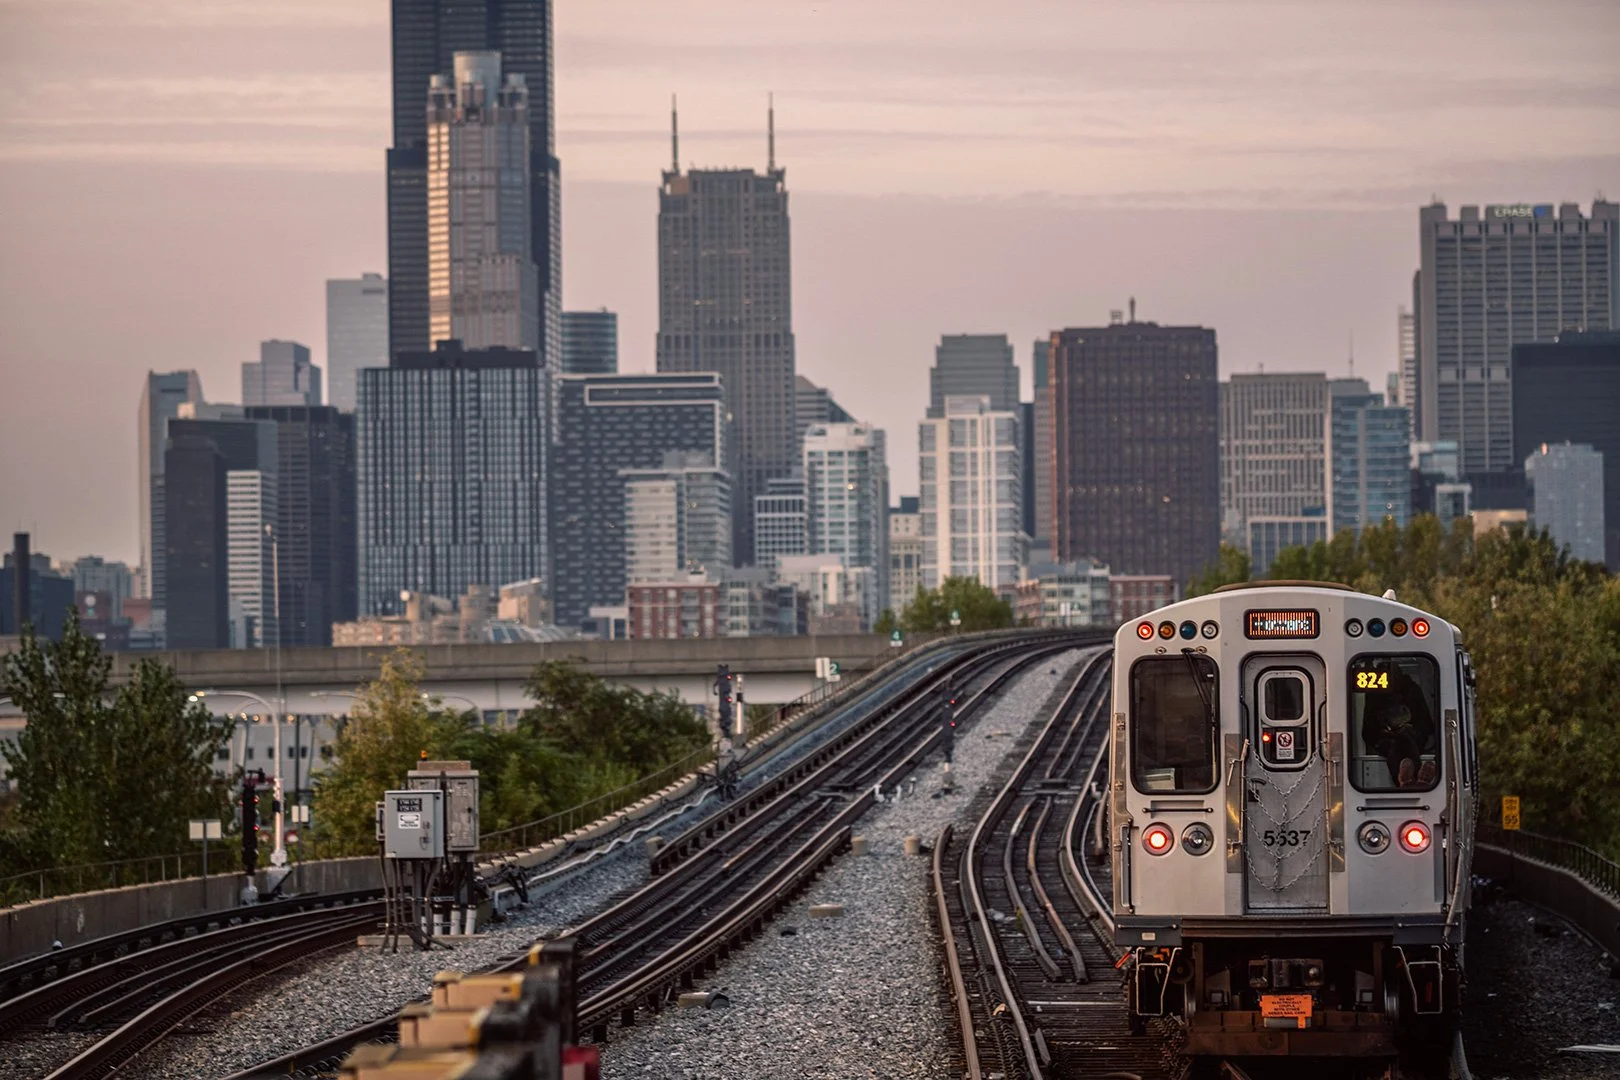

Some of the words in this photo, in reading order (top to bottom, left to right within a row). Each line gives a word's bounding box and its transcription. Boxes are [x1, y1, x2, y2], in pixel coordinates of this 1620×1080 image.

[892, 630, 900, 641] 4
[829, 663, 838, 675] 2
[1356, 671, 1389, 689] 824
[1263, 830, 1311, 847] 5537
